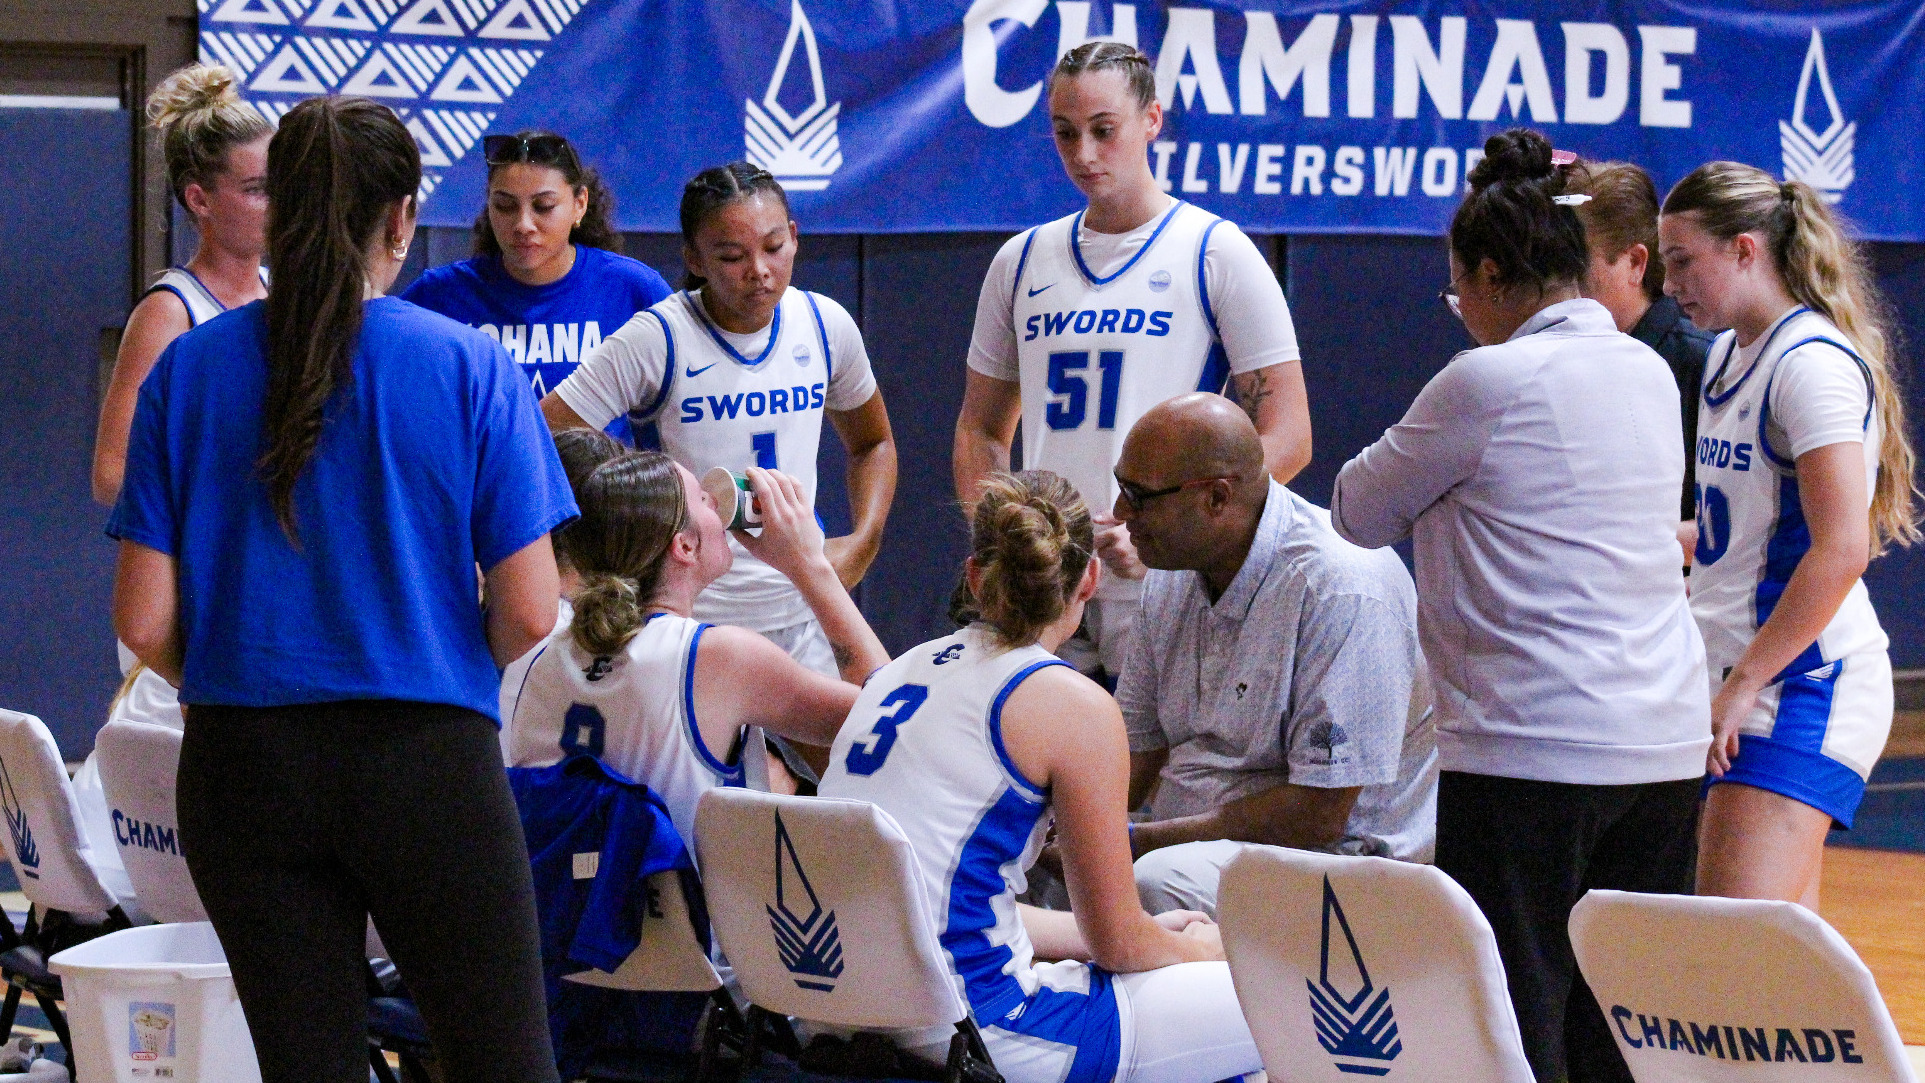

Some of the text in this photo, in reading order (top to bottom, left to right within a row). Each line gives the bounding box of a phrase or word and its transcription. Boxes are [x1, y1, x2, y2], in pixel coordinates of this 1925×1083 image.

[1152, 141, 1486, 197] ILVERSWO
[1025, 308, 1174, 341] SWORDS
[681, 383, 824, 423] SWORDS
[1045, 350, 1125, 431] 51
[750, 431, 779, 470] 1
[1697, 436, 1753, 471] ORDS
[845, 683, 930, 777] 3
[1611, 1004, 1863, 1063] CHAMINADE
